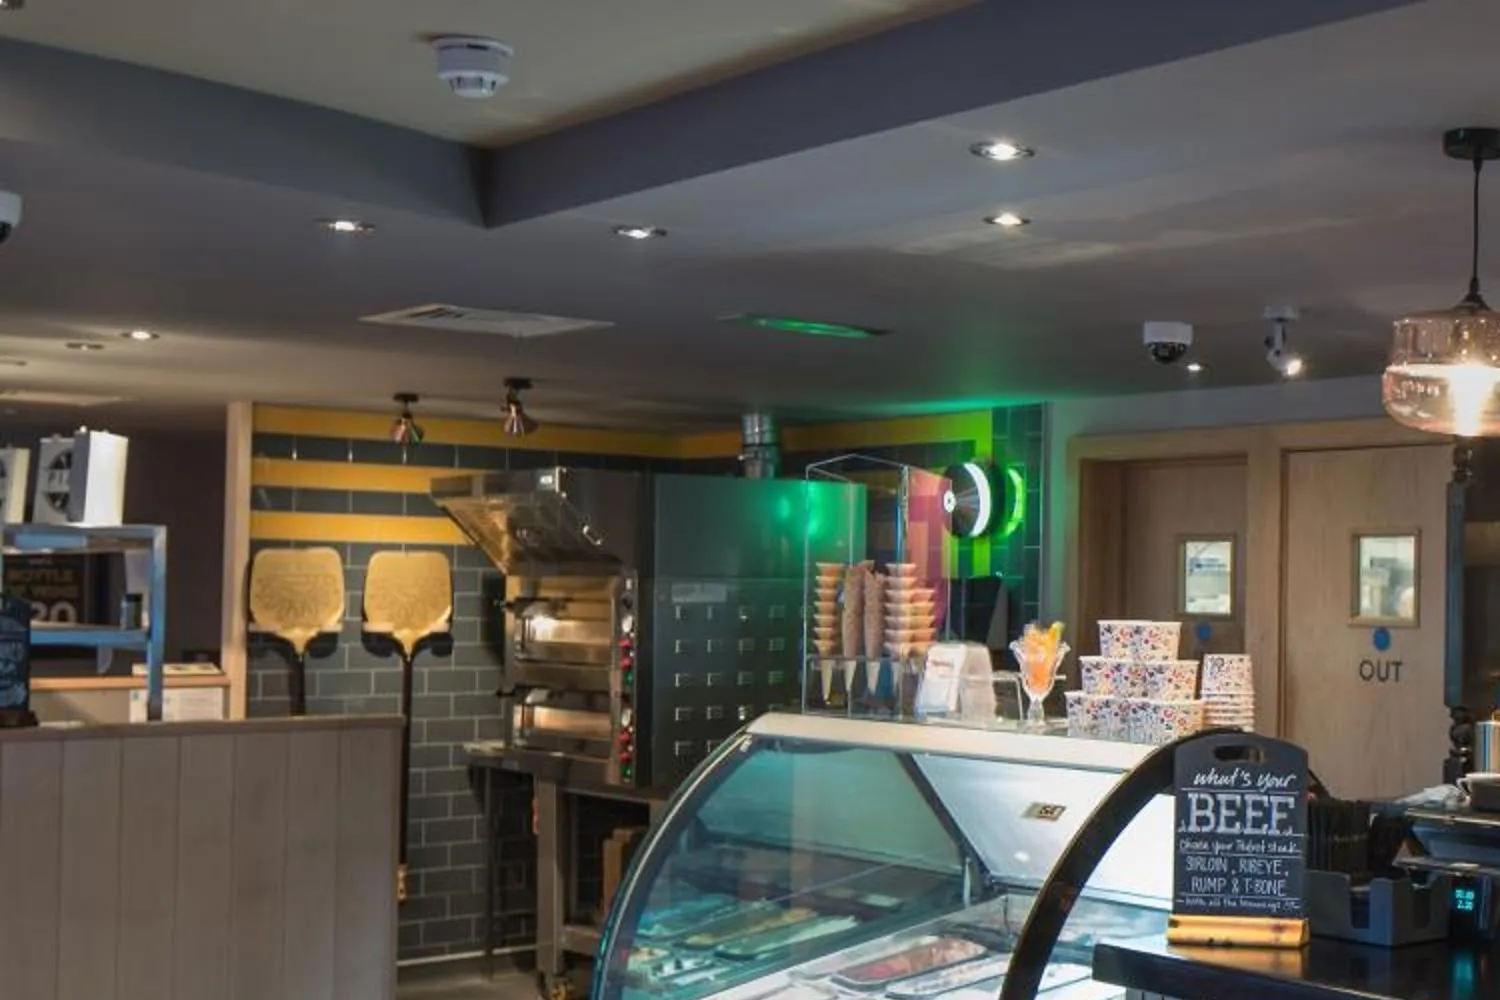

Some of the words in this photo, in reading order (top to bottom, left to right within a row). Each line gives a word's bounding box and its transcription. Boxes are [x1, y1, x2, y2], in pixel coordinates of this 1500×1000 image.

[1359, 659, 1404, 683] OUT
[1258, 772, 1297, 793] your
[1187, 792, 1296, 836] BEEF
[1191, 876, 1227, 893] RUMP
